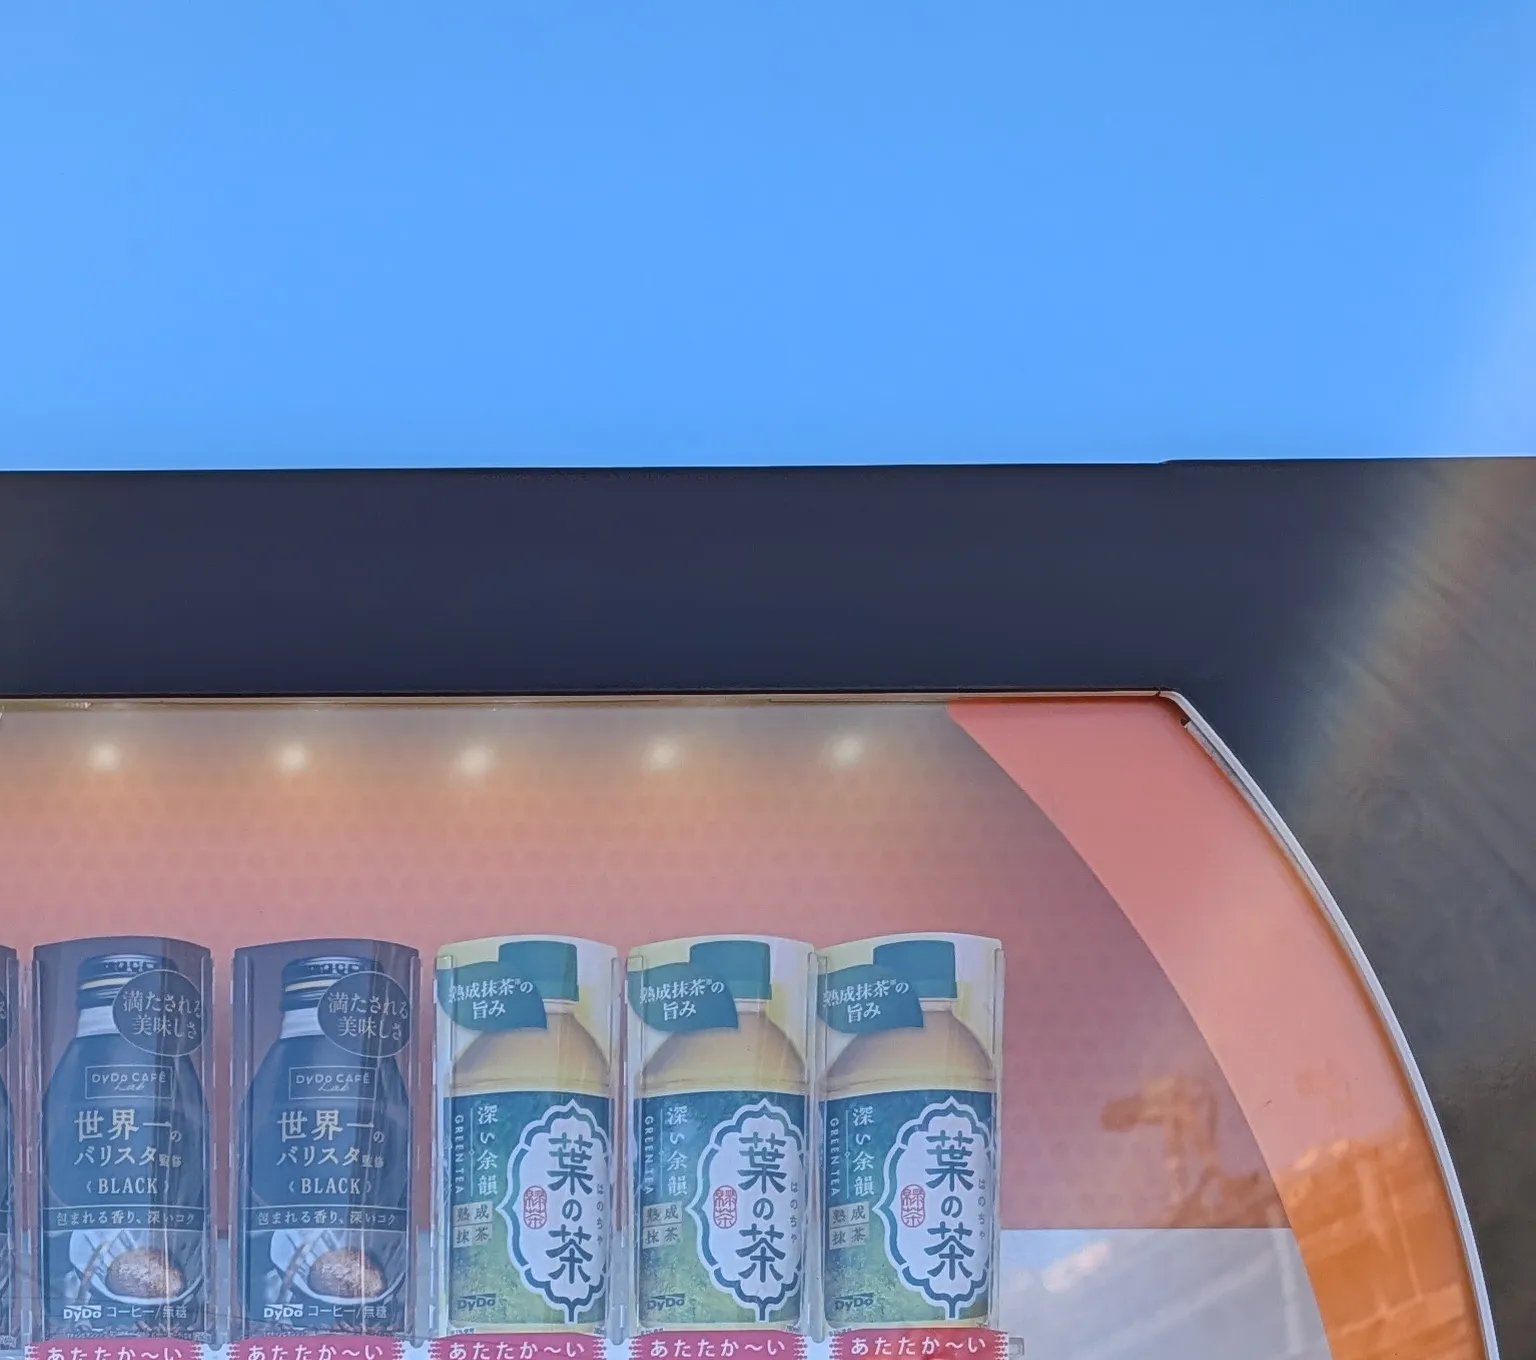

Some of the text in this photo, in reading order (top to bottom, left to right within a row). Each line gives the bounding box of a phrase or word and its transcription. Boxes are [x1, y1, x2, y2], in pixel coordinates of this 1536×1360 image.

[547, 1131, 594, 1284] 葉の茶
[737, 1132, 784, 1284] 葉の茶
[924, 1131, 973, 1283] 葉の茶
